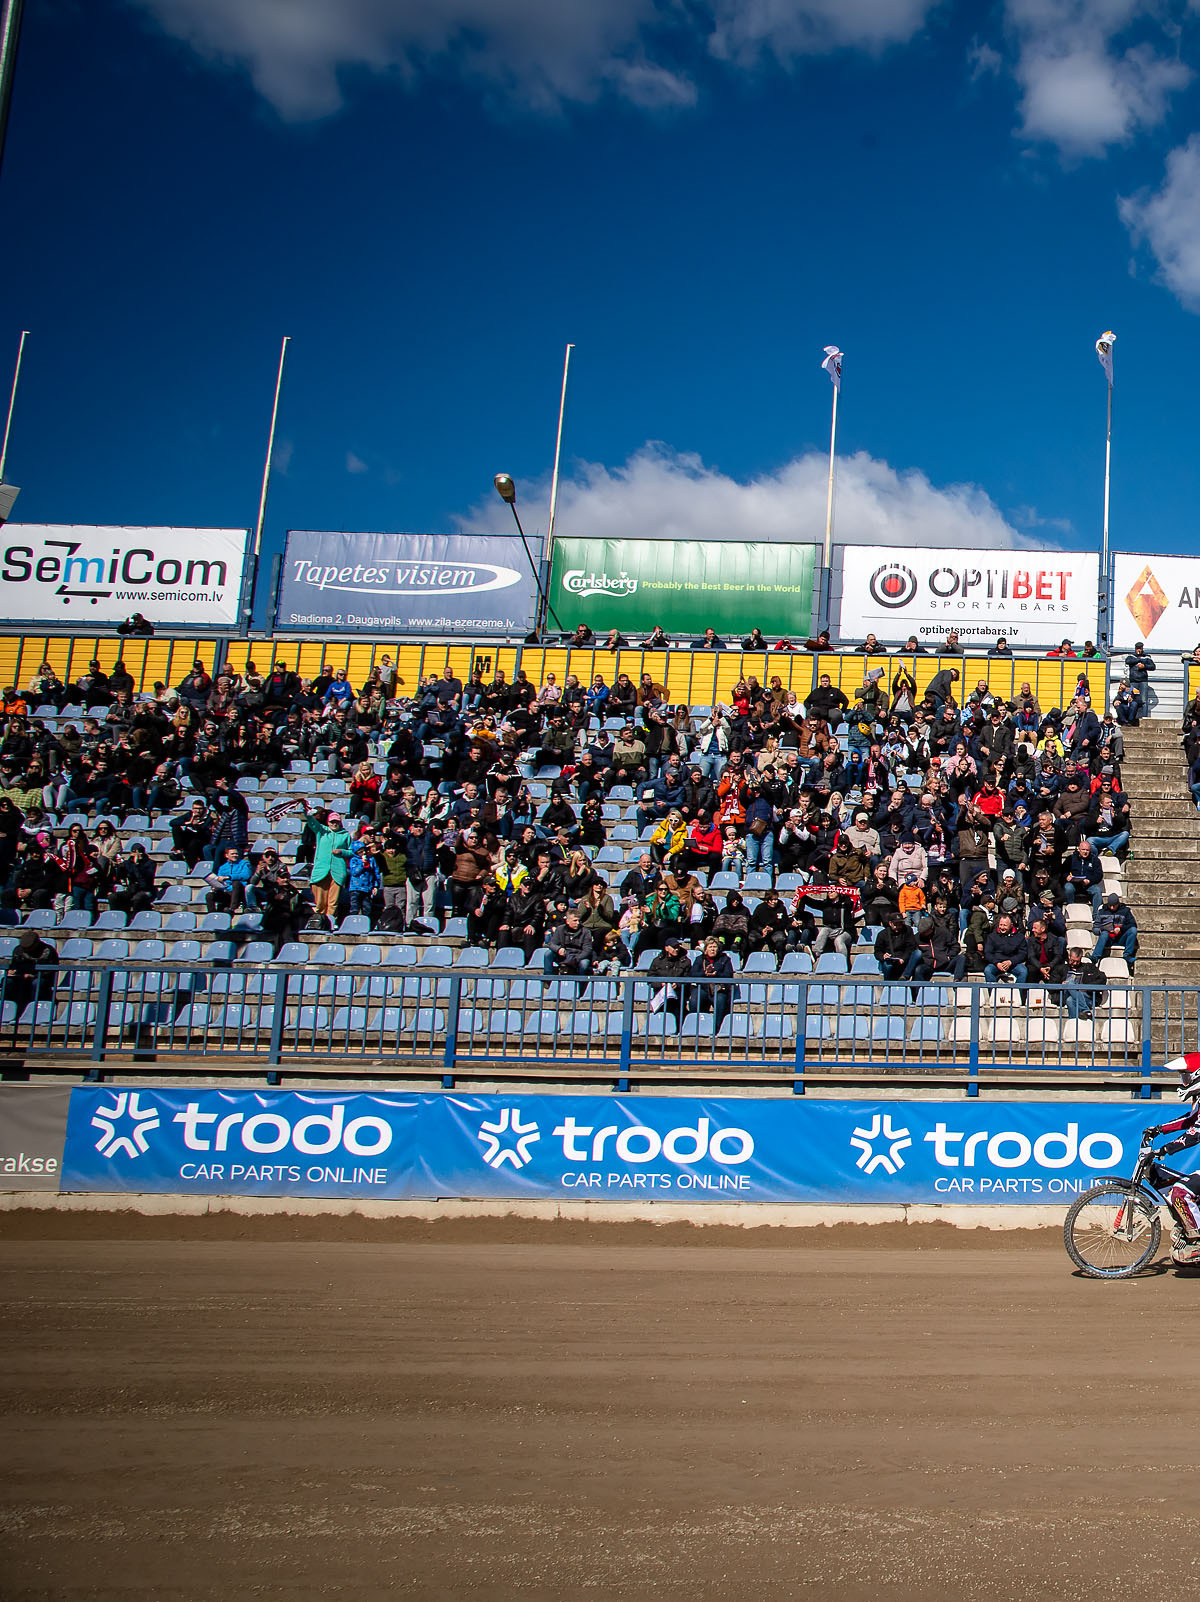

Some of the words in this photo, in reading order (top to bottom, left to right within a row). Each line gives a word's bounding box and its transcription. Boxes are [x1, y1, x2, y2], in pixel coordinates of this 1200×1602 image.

[1, 545, 228, 587] SemiCom
[293, 560, 389, 591] Tapetes
[395, 565, 476, 586] visiem
[562, 570, 639, 596] Carlsberg
[928, 567, 1073, 601] OPTIBET
[115, 589, 224, 602] www.semicom.lv
[642, 580, 682, 591] Probably
[684, 581, 699, 590] the
[701, 582, 721, 590] Best
[723, 583, 744, 591] Beer
[746, 583, 755, 591] in
[756, 583, 771, 592] the
[774, 584, 801, 593] World
[930, 600, 1006, 611] SPORTA
[1020, 602, 1069, 612] BĀRS
[290, 613, 333, 624] Stadiona
[347, 614, 401, 627] Daugavpils
[408, 617, 514, 628] www.zila-ezerzeme.lv
[919, 625, 1019, 636] optibetsportabars.lv
[475, 656, 491, 673] M
[172, 1102, 394, 1157] trodo
[551, 1116, 755, 1165] trodo
[923, 1122, 1124, 1169] trodo
[180, 1163, 225, 1181] CAR
[230, 1164, 301, 1182] PARTS
[306, 1166, 388, 1185] ONLINE
[561, 1172, 602, 1188] CAR
[607, 1173, 672, 1189] PARTS
[676, 1174, 751, 1190] ONLINE
[934, 1177, 974, 1193] CAR
[980, 1177, 1043, 1193] PARTS
